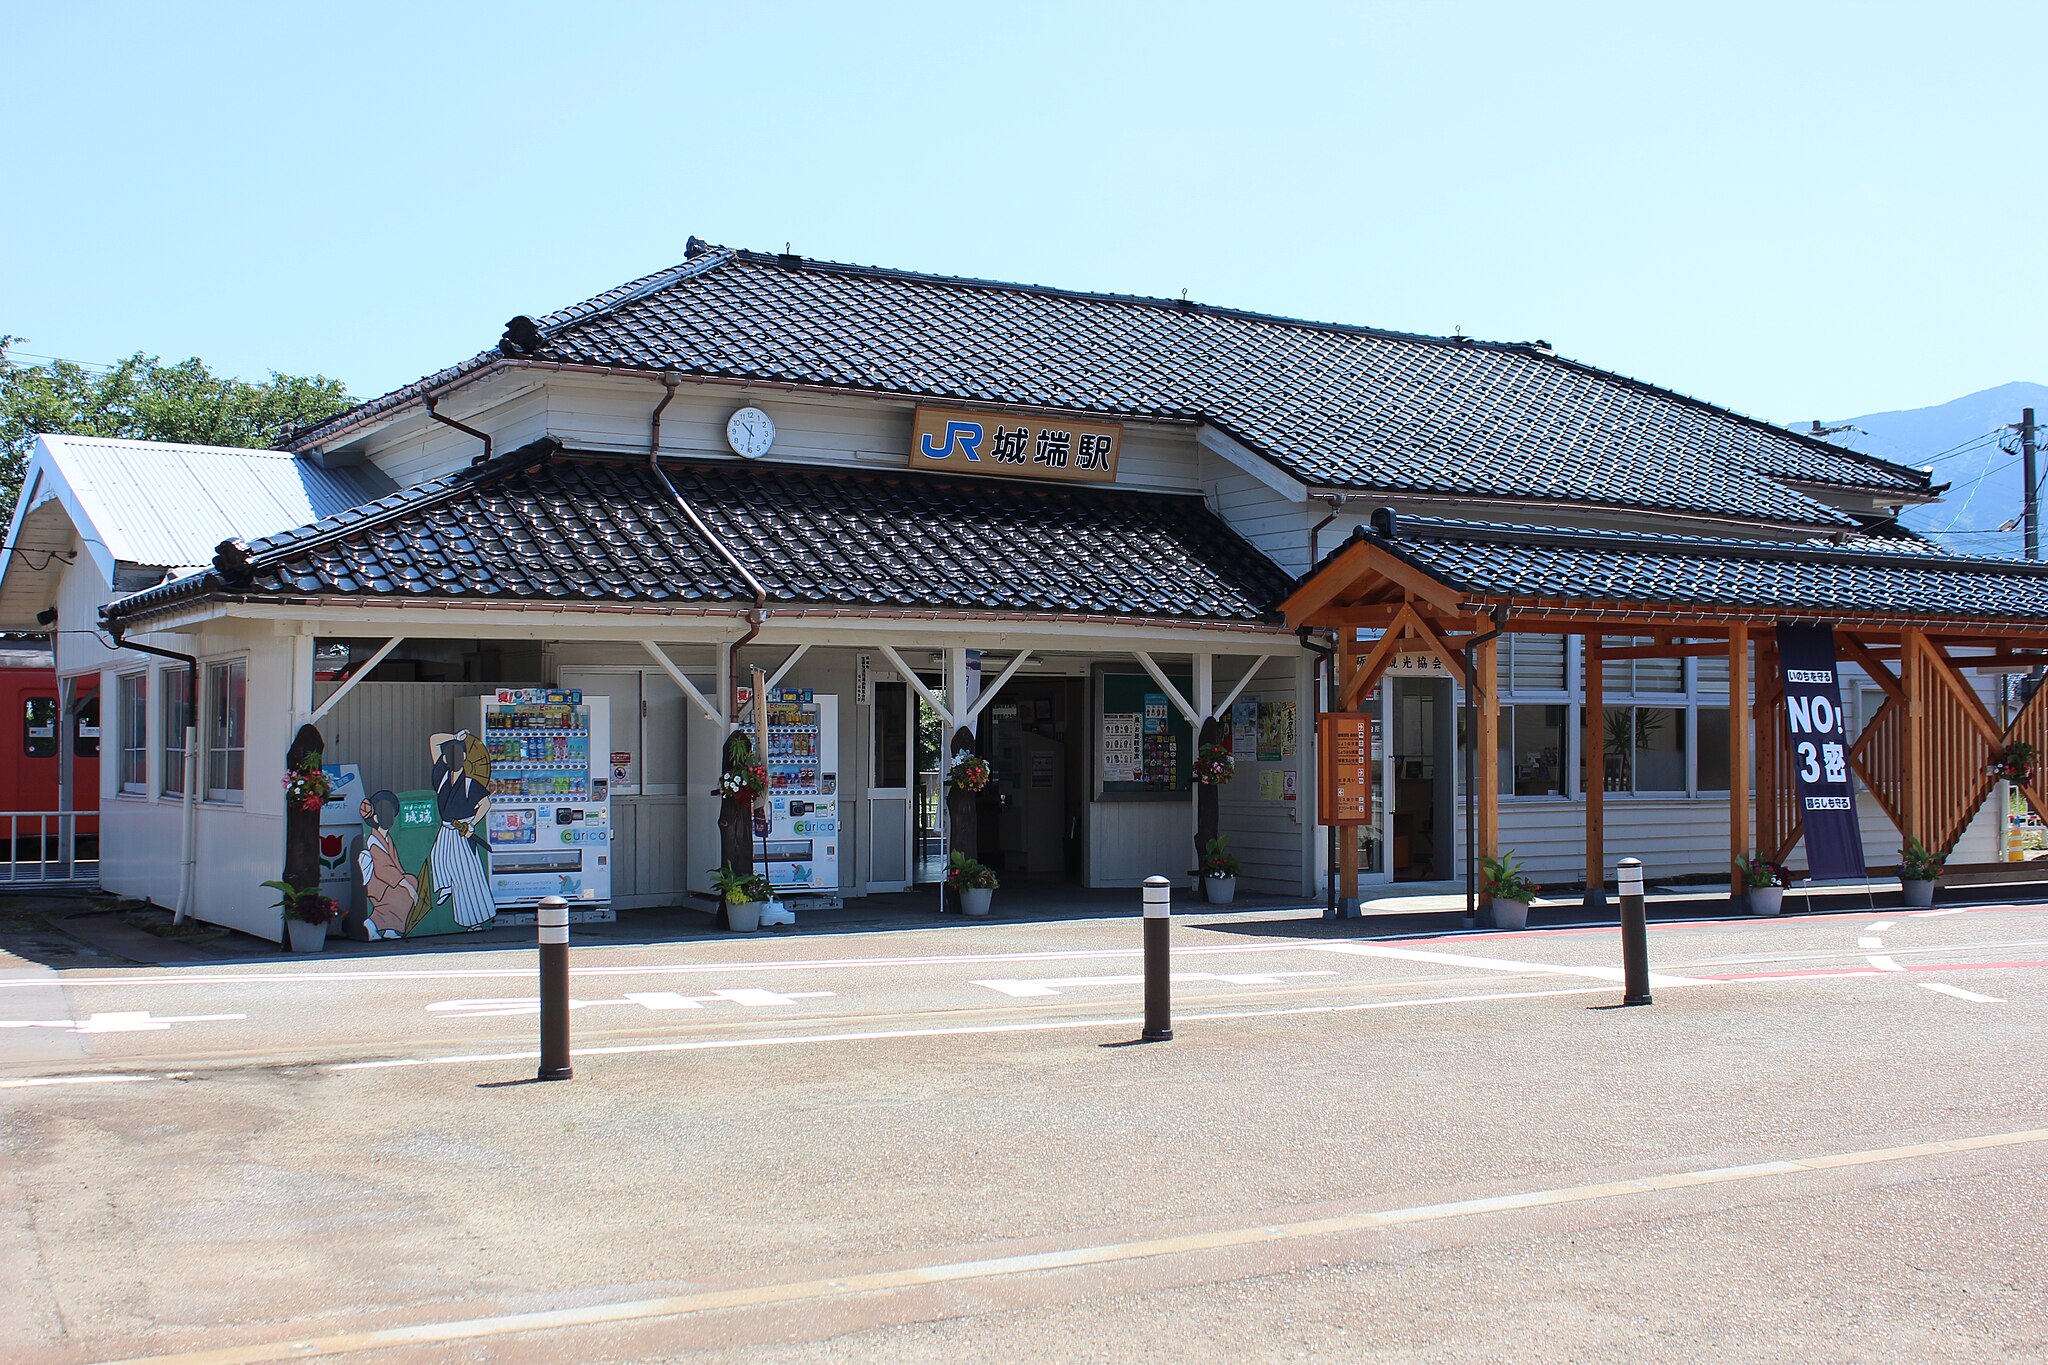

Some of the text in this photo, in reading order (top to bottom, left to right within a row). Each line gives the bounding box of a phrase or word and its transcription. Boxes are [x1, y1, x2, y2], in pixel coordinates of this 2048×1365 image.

[921, 420, 1112, 471] JR 城端駅
[1788, 672, 1831, 682] いのちを守る
[1787, 696, 1843, 734] NO!
[1798, 742, 1846, 783] 3密
[1806, 799, 1849, 808] 暮らしも守る
[795, 821, 834, 833] curico
[562, 829, 606, 842] curico
